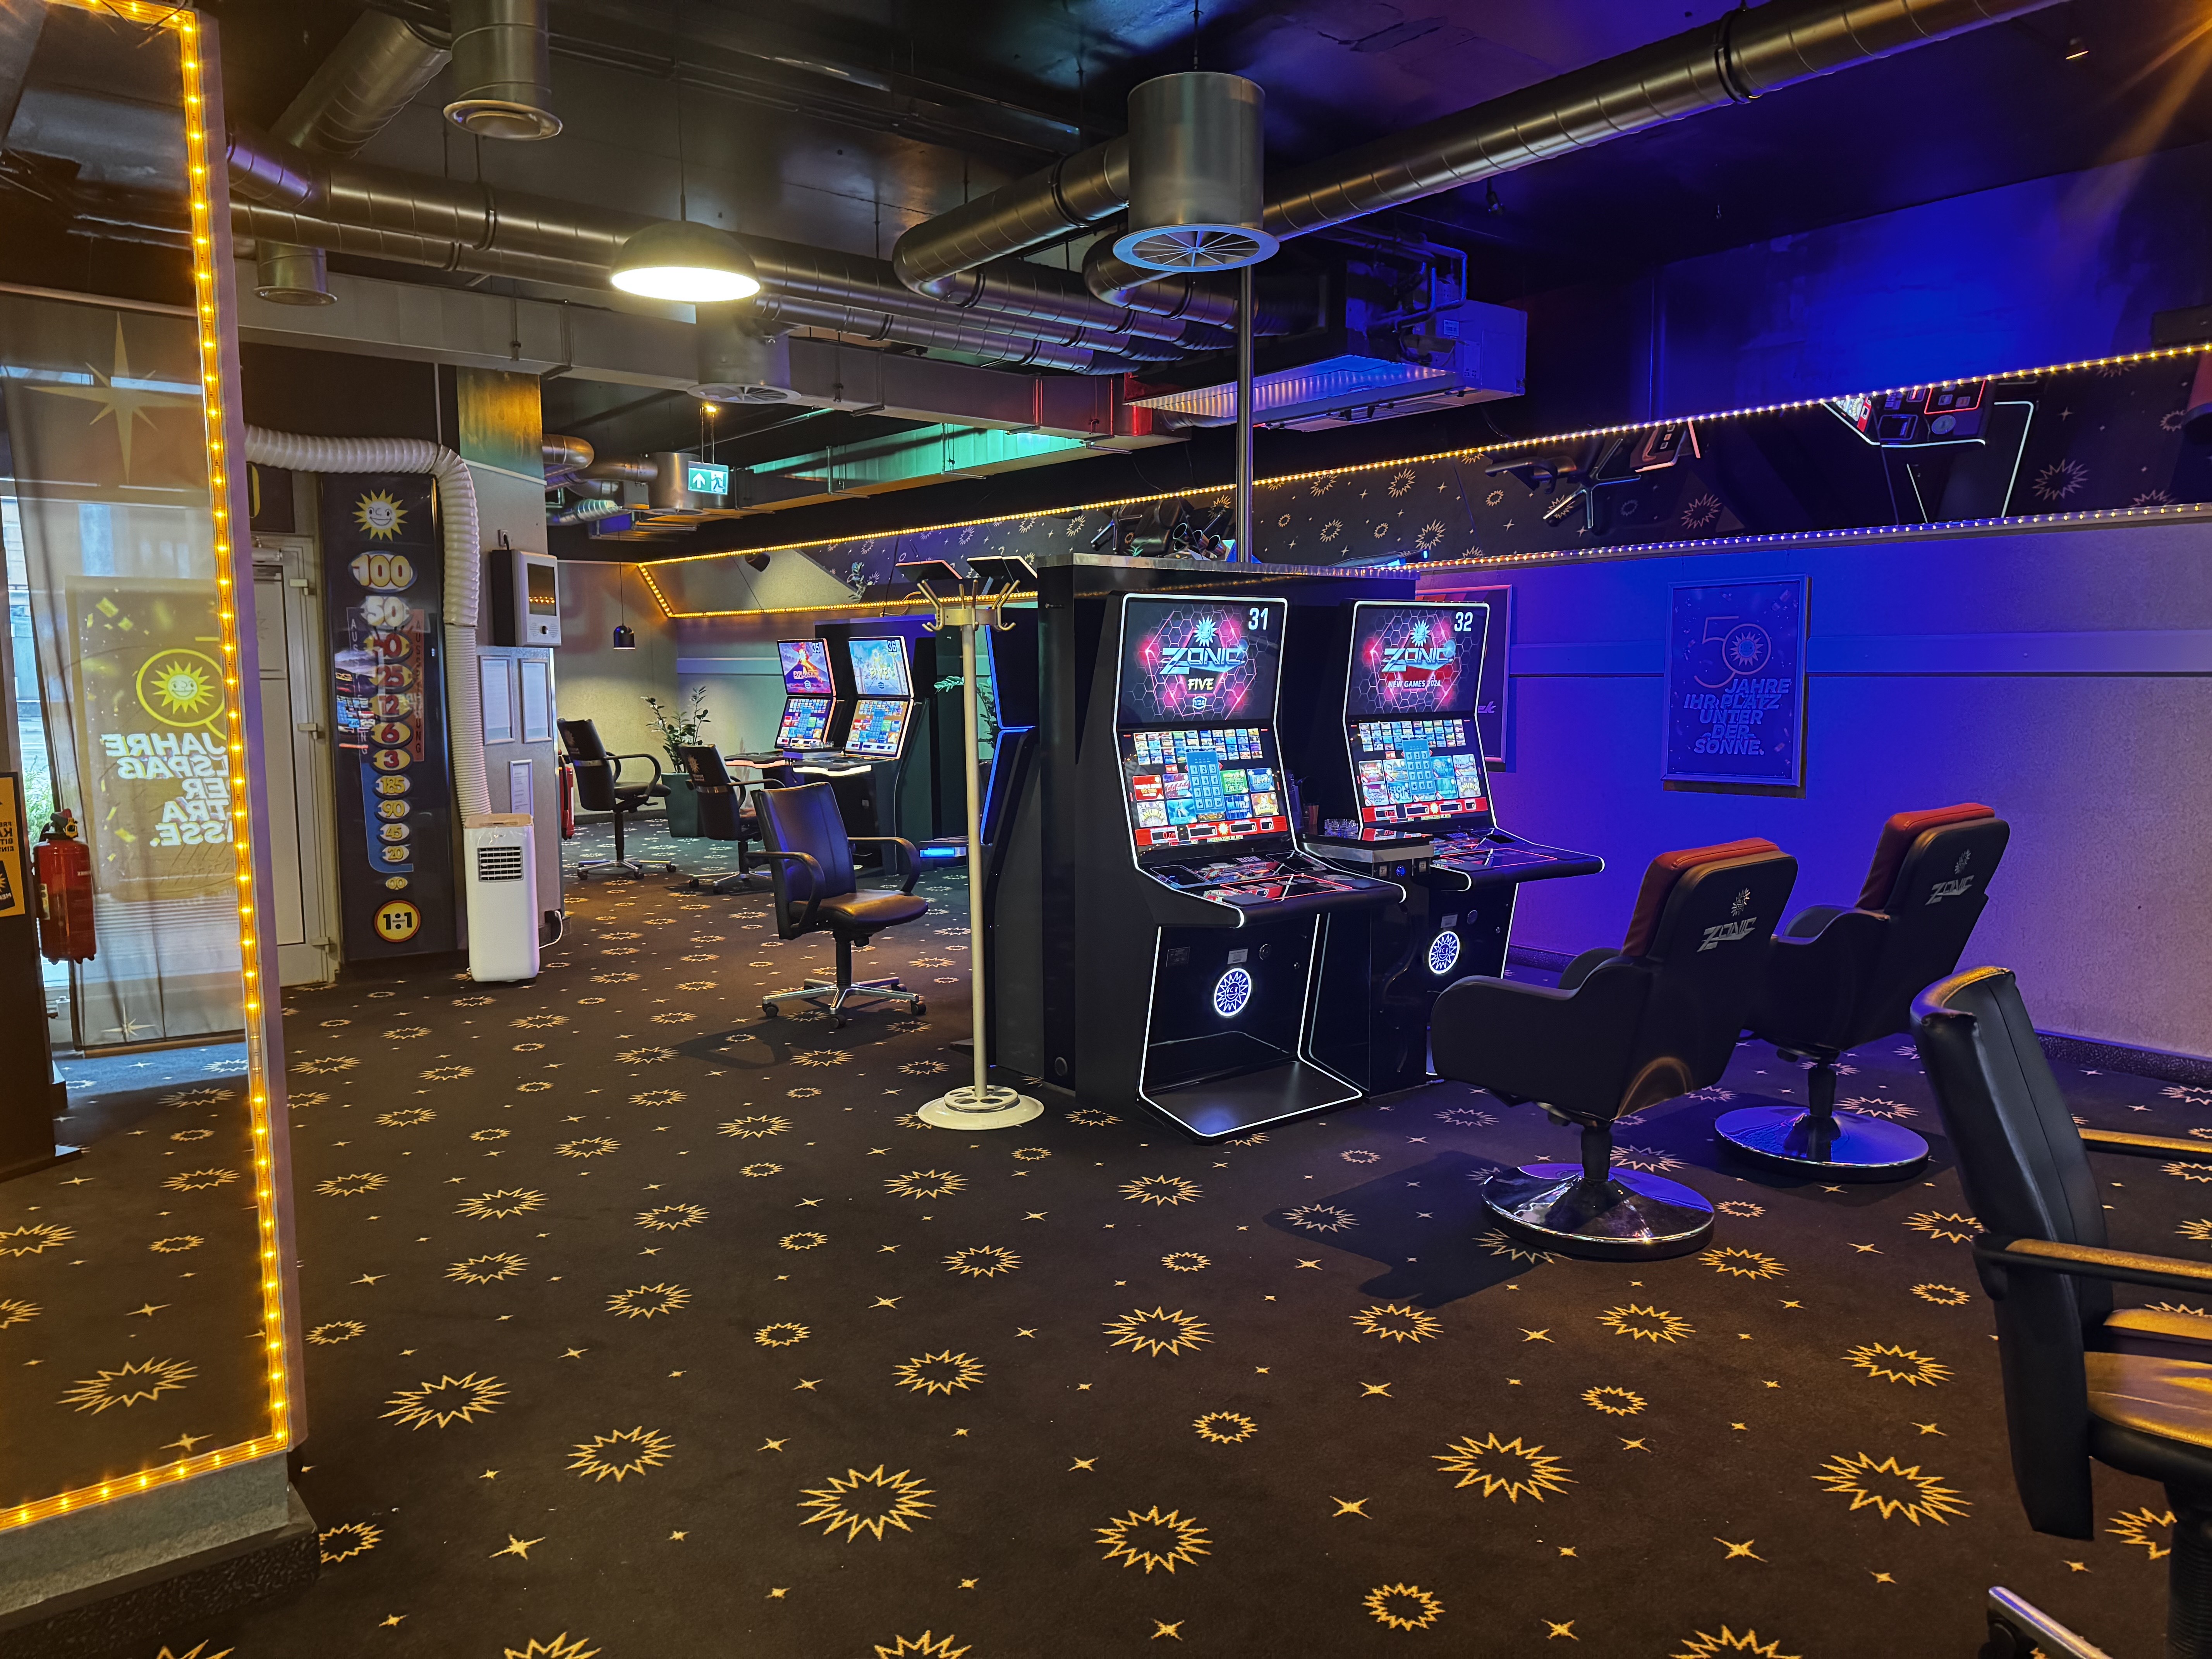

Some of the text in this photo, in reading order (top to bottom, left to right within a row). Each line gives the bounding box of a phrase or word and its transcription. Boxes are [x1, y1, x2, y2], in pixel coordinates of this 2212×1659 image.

[351, 554, 411, 587] 100
[367, 596, 404, 627] 50
[1248, 607, 1268, 630] 31
[1454, 611, 1473, 632] 32
[812, 643, 820, 653] 35
[887, 641, 896, 652] 36
[1694, 616, 1771, 688] 50
[1159, 647, 1245, 674] ZONIC
[1382, 648, 1453, 672] ZONIC
[378, 665, 404, 687] 25
[1188, 678, 1214, 690] FIVE
[1725, 678, 1792, 694] JAHRE
[378, 694, 400, 716] 12
[1683, 694, 1782, 709] IHR PLATZ
[1699, 709, 1764, 725] UNTER
[381, 723, 400, 743] 6
[1711, 724, 1750, 739] DER
[1693, 739, 1765, 755] SONNE.
[384, 749, 400, 768] 3
[381, 777, 405, 794] 185
[382, 800, 405, 817] 90
[386, 825, 402, 838] 45
[388, 847, 404, 860] 20
[1925, 875, 1975, 905] ZONIC
[1697, 917, 1757, 953] ZONIC
